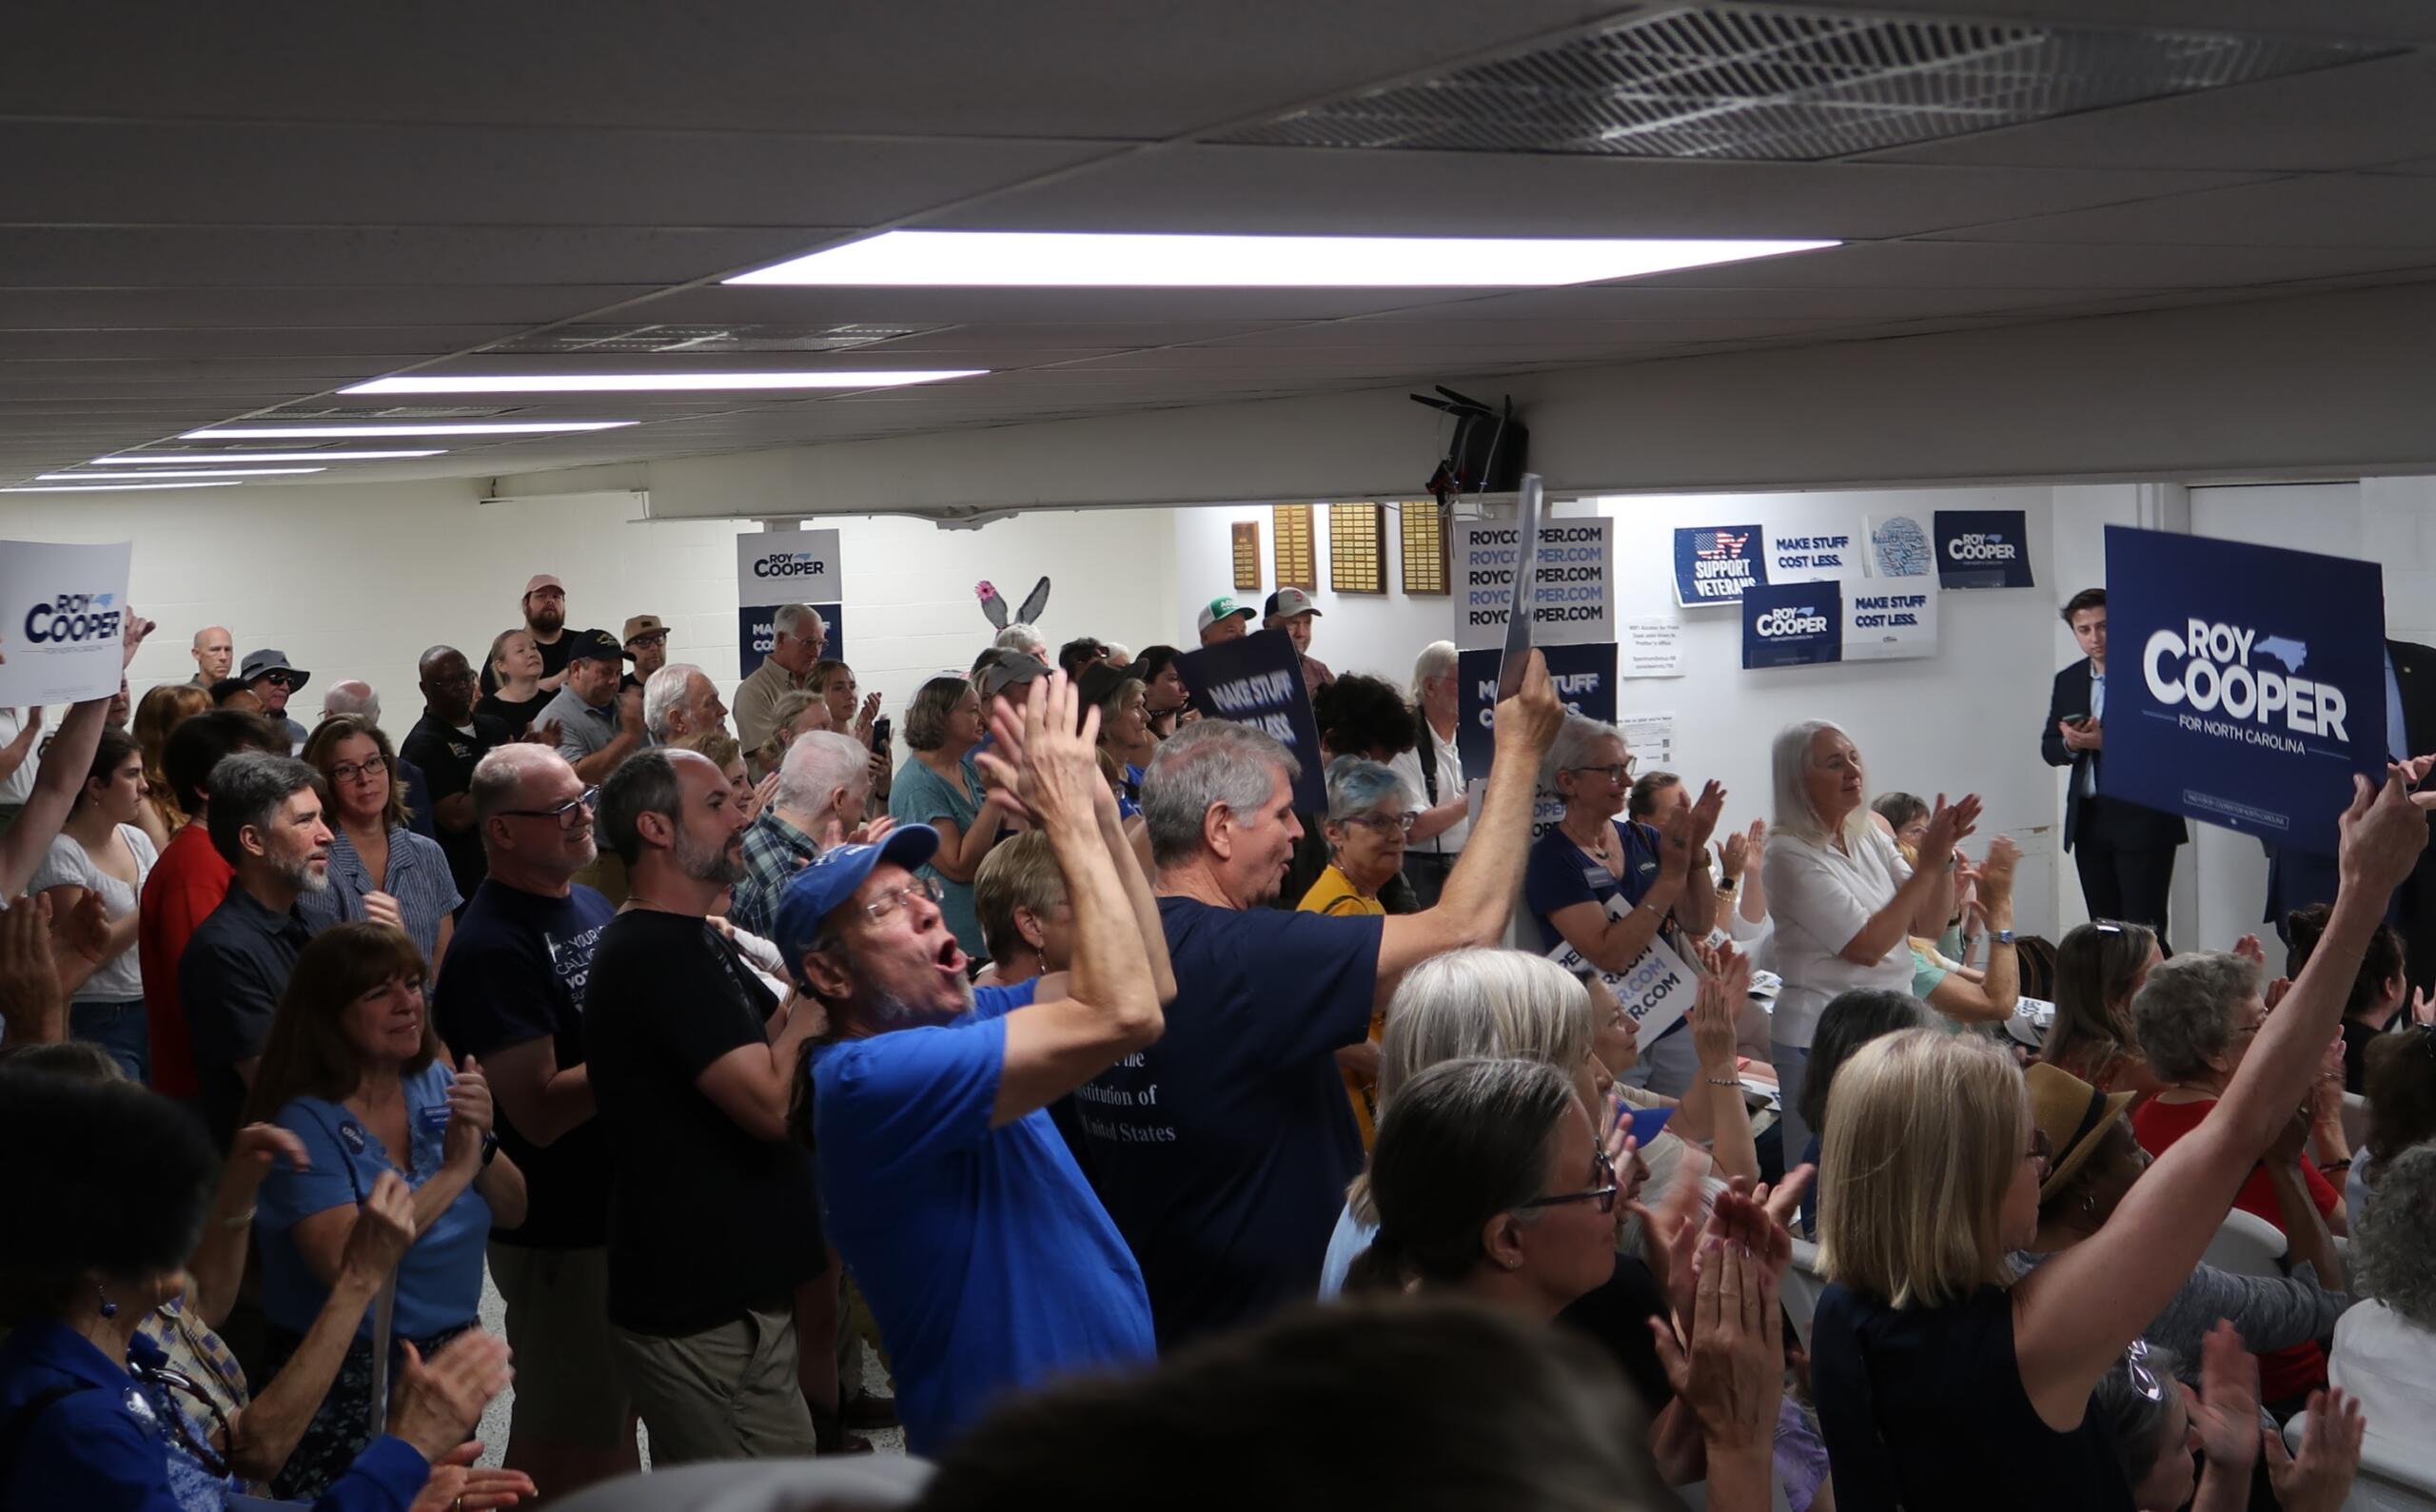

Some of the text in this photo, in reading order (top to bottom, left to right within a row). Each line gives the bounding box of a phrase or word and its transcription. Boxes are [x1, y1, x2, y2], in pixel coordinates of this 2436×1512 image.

[1470, 527, 1602, 545] ROYCOPER.COM
[1777, 536, 1848, 550] MAKE STUFF
[1963, 534, 1986, 545] ROY
[769, 554, 794, 564] ROY
[1470, 547, 1602, 565] ROYCPER.COM
[1778, 557, 1809, 569] COST
[1469, 566, 1602, 586] ROYCPER.COM
[1695, 559, 1750, 579] SUPPORT
[56, 594, 93, 615] ROY
[1469, 586, 1603, 606] ROYCPER.COM
[1856, 595, 1927, 610] MAKE STUFF
[1470, 606, 1603, 626] ROYCPER.COM
[1772, 606, 1798, 619] ROY
[1856, 615, 1885, 628] COST
[752, 623, 776, 637] MA
[2188, 617, 2255, 666] ROY
[1553, 673, 1601, 694] TUFF
[2178, 714, 2307, 756] FOR NORTH CAROLINA
[1138, 1084, 1157, 1106] of
[1119, 1123, 1178, 1143] States
